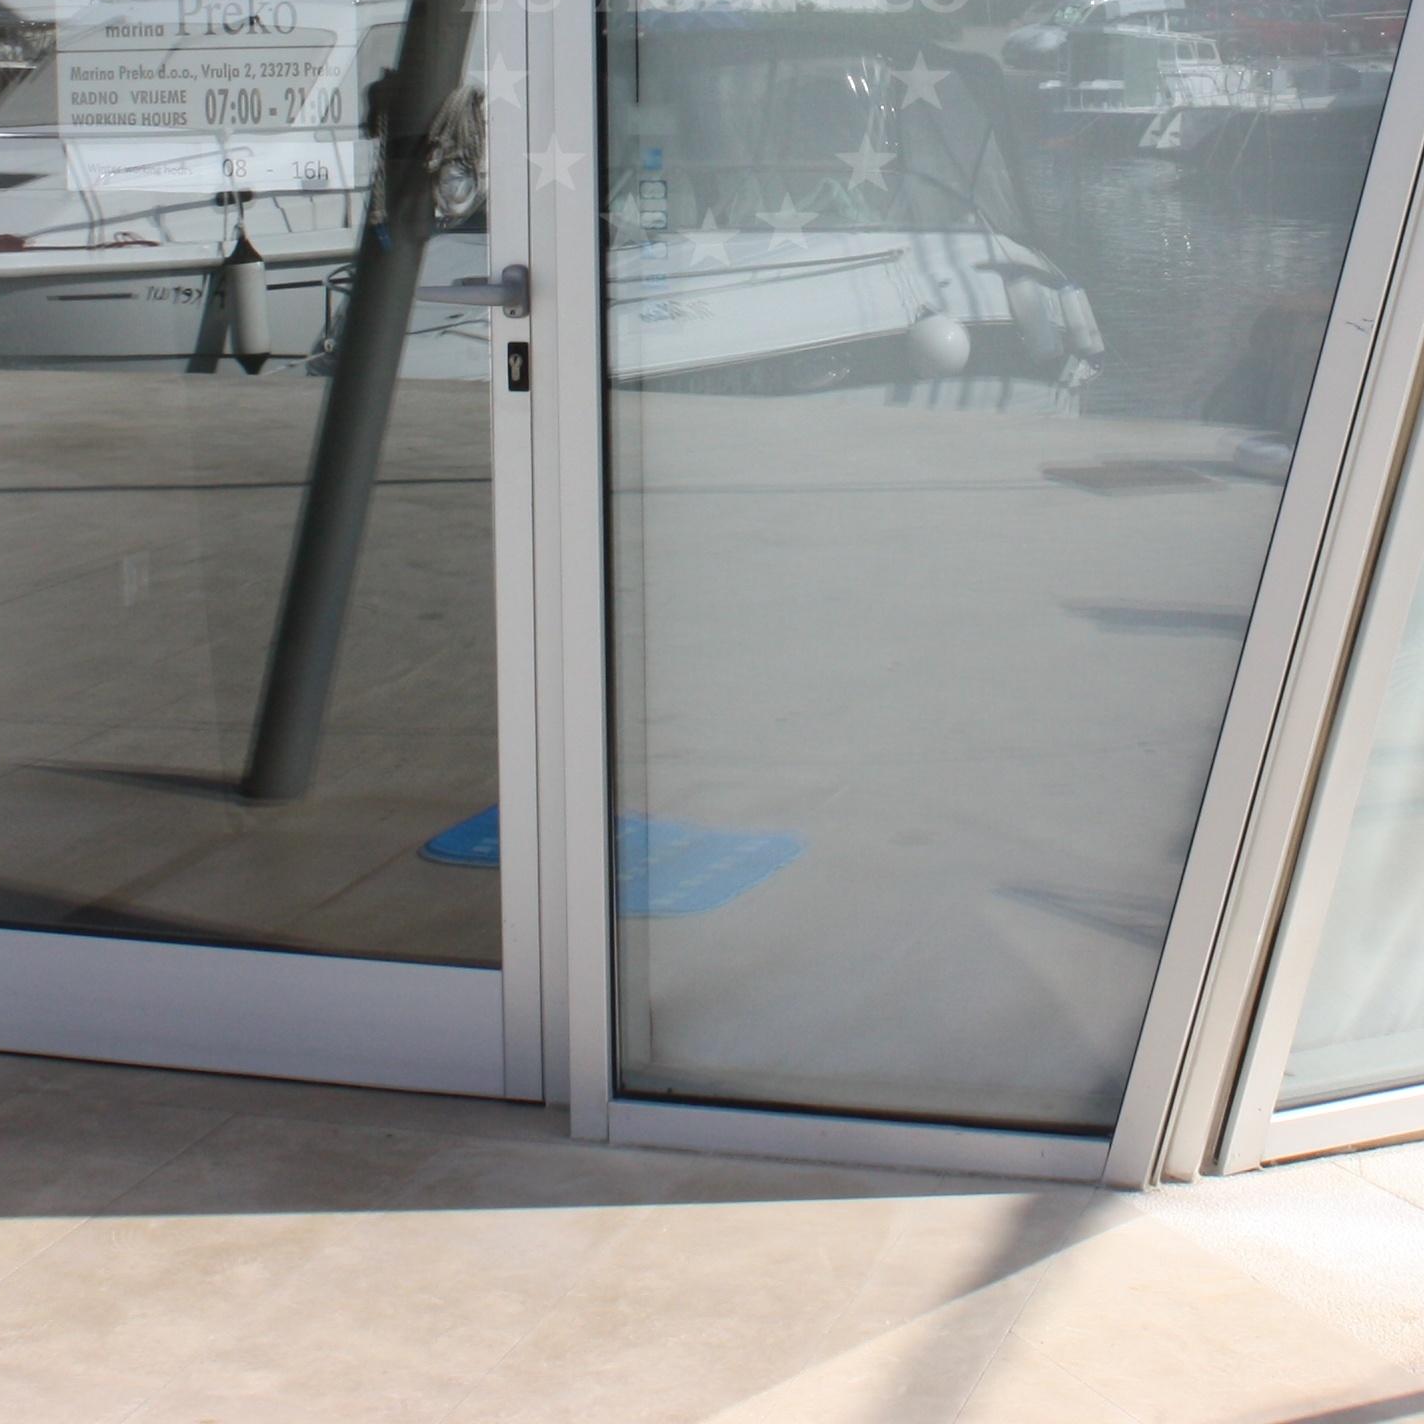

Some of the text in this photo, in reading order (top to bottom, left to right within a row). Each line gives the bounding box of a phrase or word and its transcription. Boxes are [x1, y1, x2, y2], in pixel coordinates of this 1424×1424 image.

[105, 22, 164, 37] marina
[70, 66, 115, 81] Marina
[119, 64, 154, 80] Preko
[158, 64, 197, 81] d.o.o.,
[201, 63, 240, 81] Vrulja
[244, 63, 256, 80] 2,
[260, 62, 300, 77] 23273
[71, 89, 187, 105] RADNO VRIJEME
[205, 87, 262, 125] 07:00
[284, 87, 342, 125] 21:00
[71, 112, 188, 126] WORKING HOURS
[222, 159, 247, 177] 08
[291, 160, 329, 180] 16h
